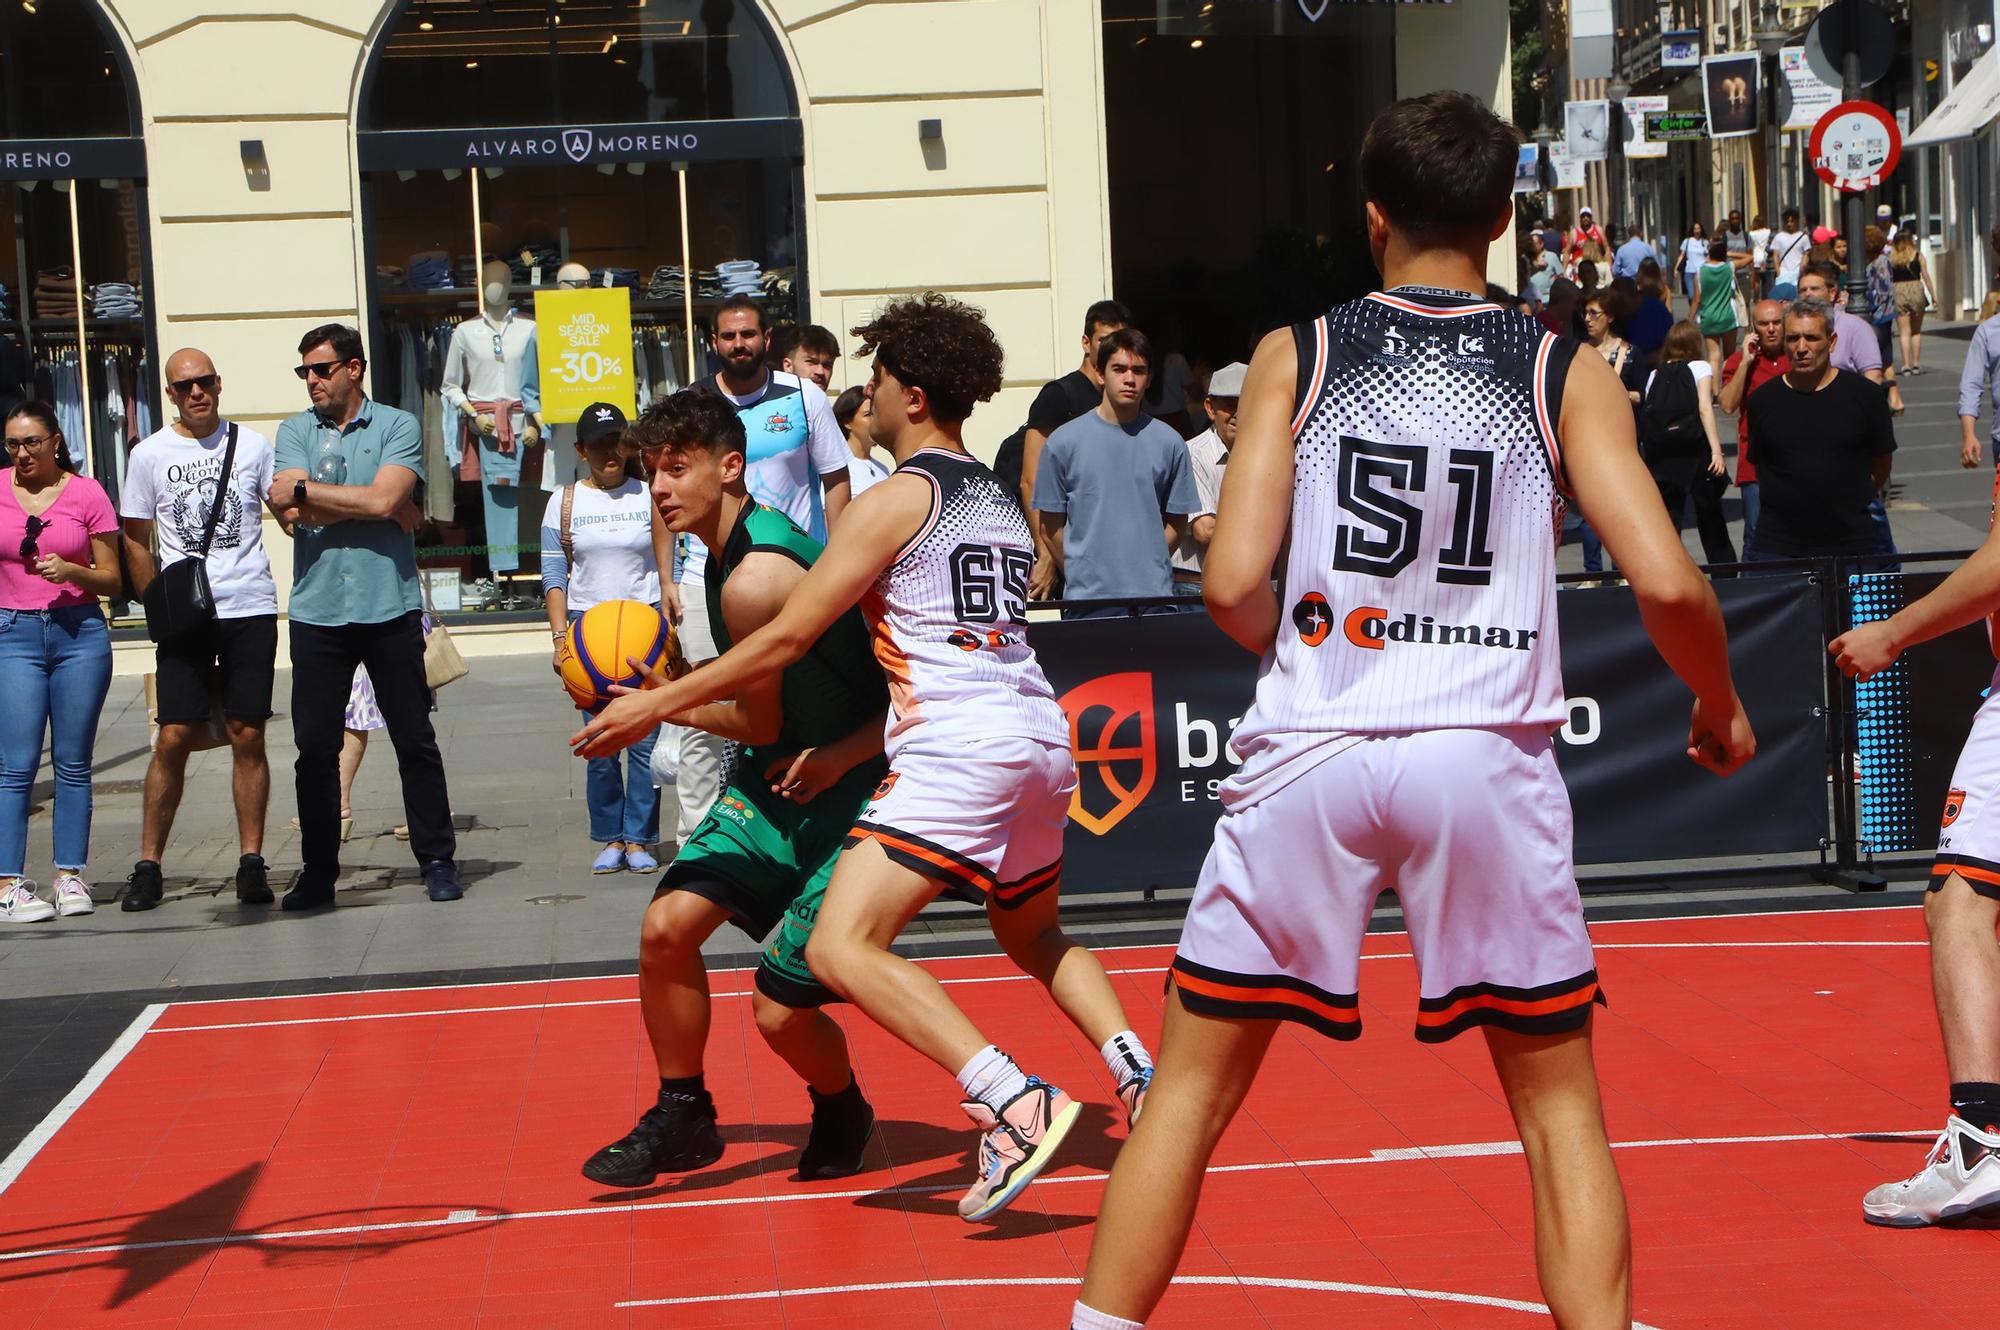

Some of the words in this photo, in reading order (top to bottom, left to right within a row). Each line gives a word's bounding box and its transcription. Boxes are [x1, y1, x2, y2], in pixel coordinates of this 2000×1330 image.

[466, 139, 557, 157] ALVARO
[571, 135, 585, 152] A
[598, 134, 697, 152] MORENO
[0, 151, 71, 168] RENO
[1394, 286, 1472, 298] ARMOUR
[571, 313, 596, 325] MID
[559, 324, 610, 336] SEASON
[569, 335, 601, 347] SALE
[550, 351, 623, 383] -30%
[167, 457, 222, 483] QUALITY
[186, 466, 240, 485] CLOTHG
[572, 514, 608, 530] RHODE
[610, 510, 650, 522] ISLAND
[1332, 435, 1494, 585] 51
[949, 543, 1035, 626] 65
[1343, 607, 1537, 652] Codimar
